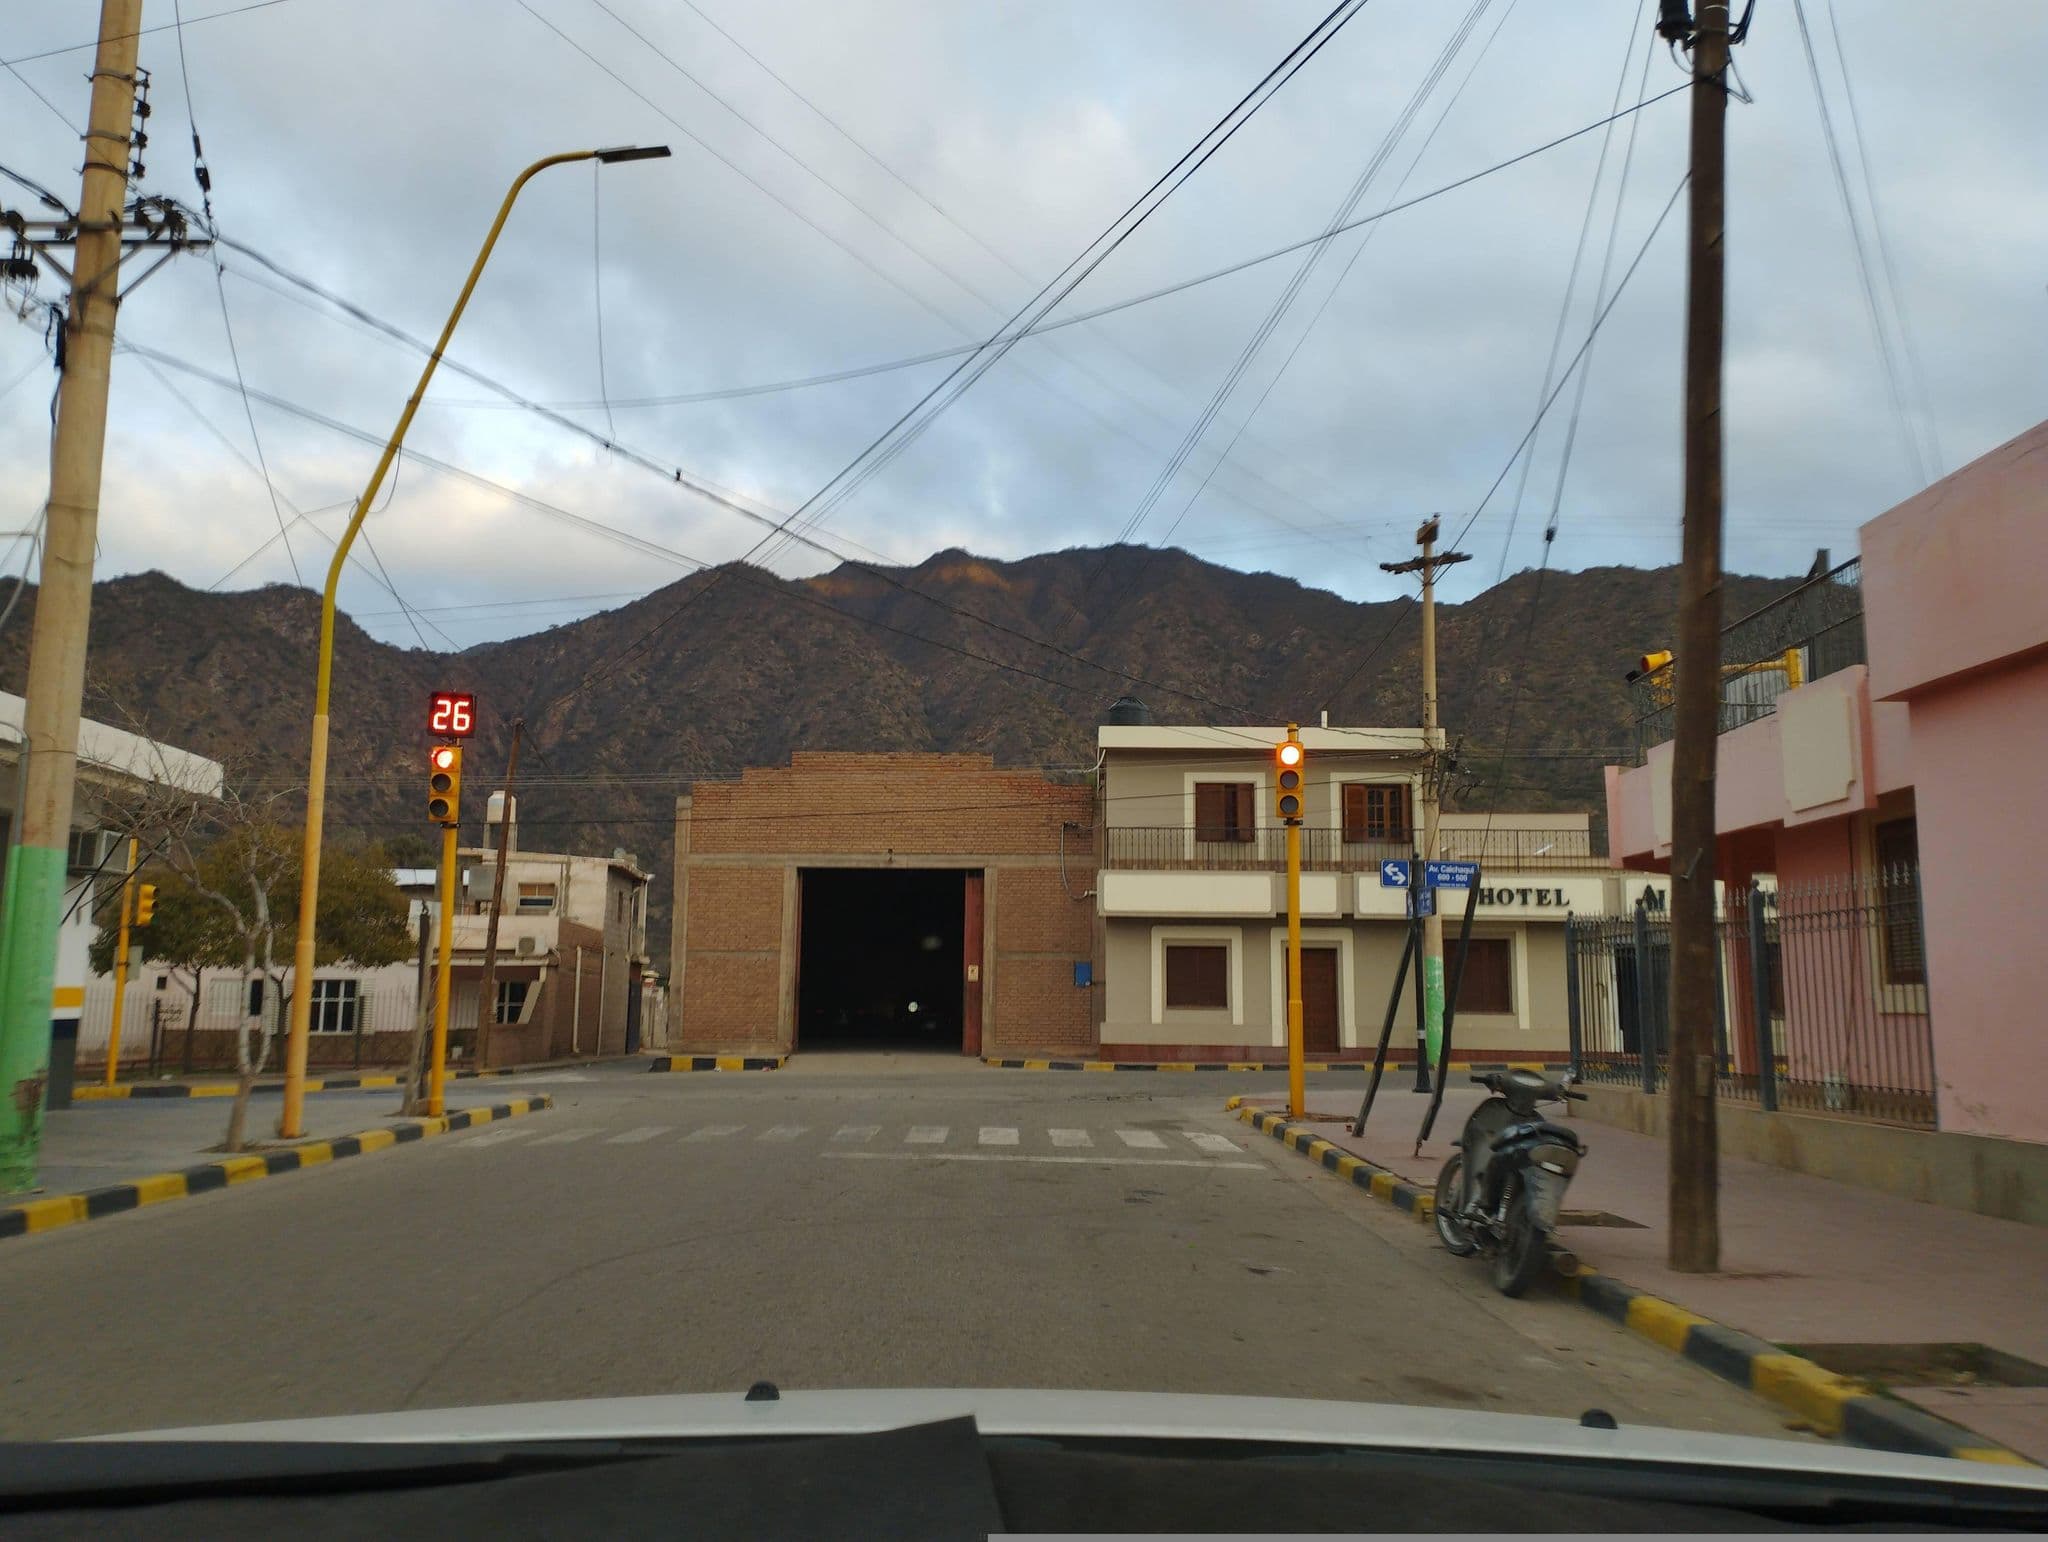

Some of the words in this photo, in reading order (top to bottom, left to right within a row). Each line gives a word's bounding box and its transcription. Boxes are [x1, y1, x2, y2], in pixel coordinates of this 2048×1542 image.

[433, 699, 470, 731] 26
[1428, 864, 1440, 873] Av.
[1478, 887, 1570, 906] HOTEL
